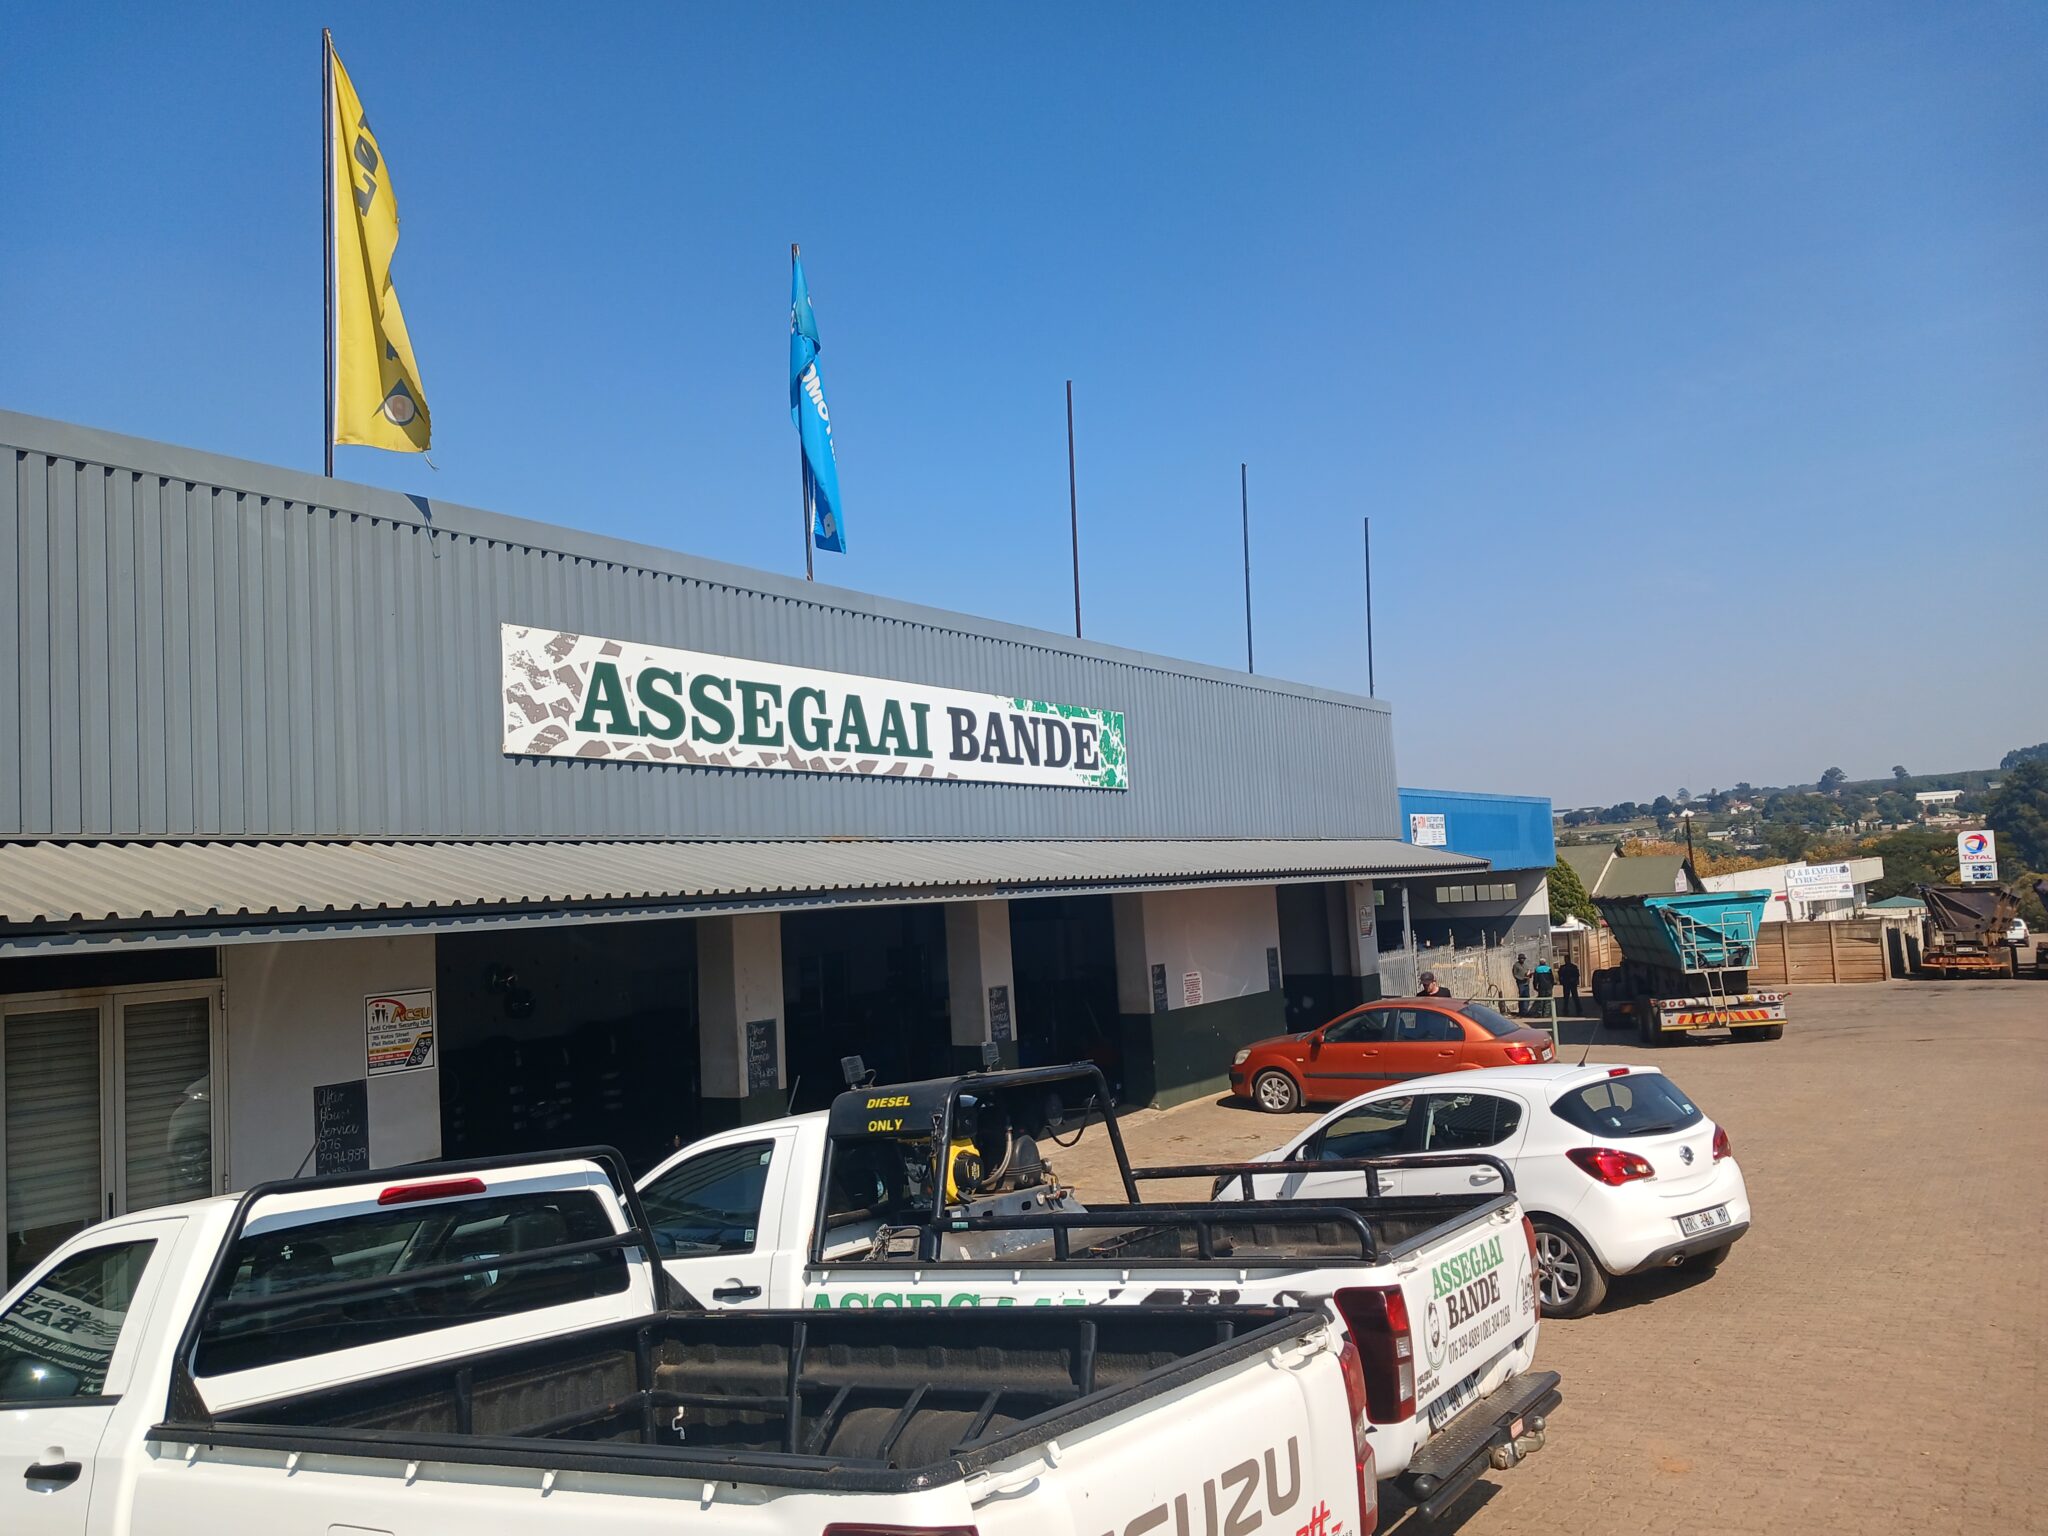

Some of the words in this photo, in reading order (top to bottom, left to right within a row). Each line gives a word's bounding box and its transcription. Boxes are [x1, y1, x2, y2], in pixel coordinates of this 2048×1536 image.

[575, 661, 933, 758] ASSEGAAI
[946, 706, 1100, 770] BANDE
[1812, 866, 1839, 874] EXPERT
[398, 1021, 420, 1029] Security
[866, 1095, 911, 1109] DIESEL
[867, 1119, 903, 1132] ONLY
[1431, 1235, 1504, 1299] ASSEGAAI
[1445, 1270, 1501, 1330] BANDE
[1101, 1435, 1301, 1536] UZU
